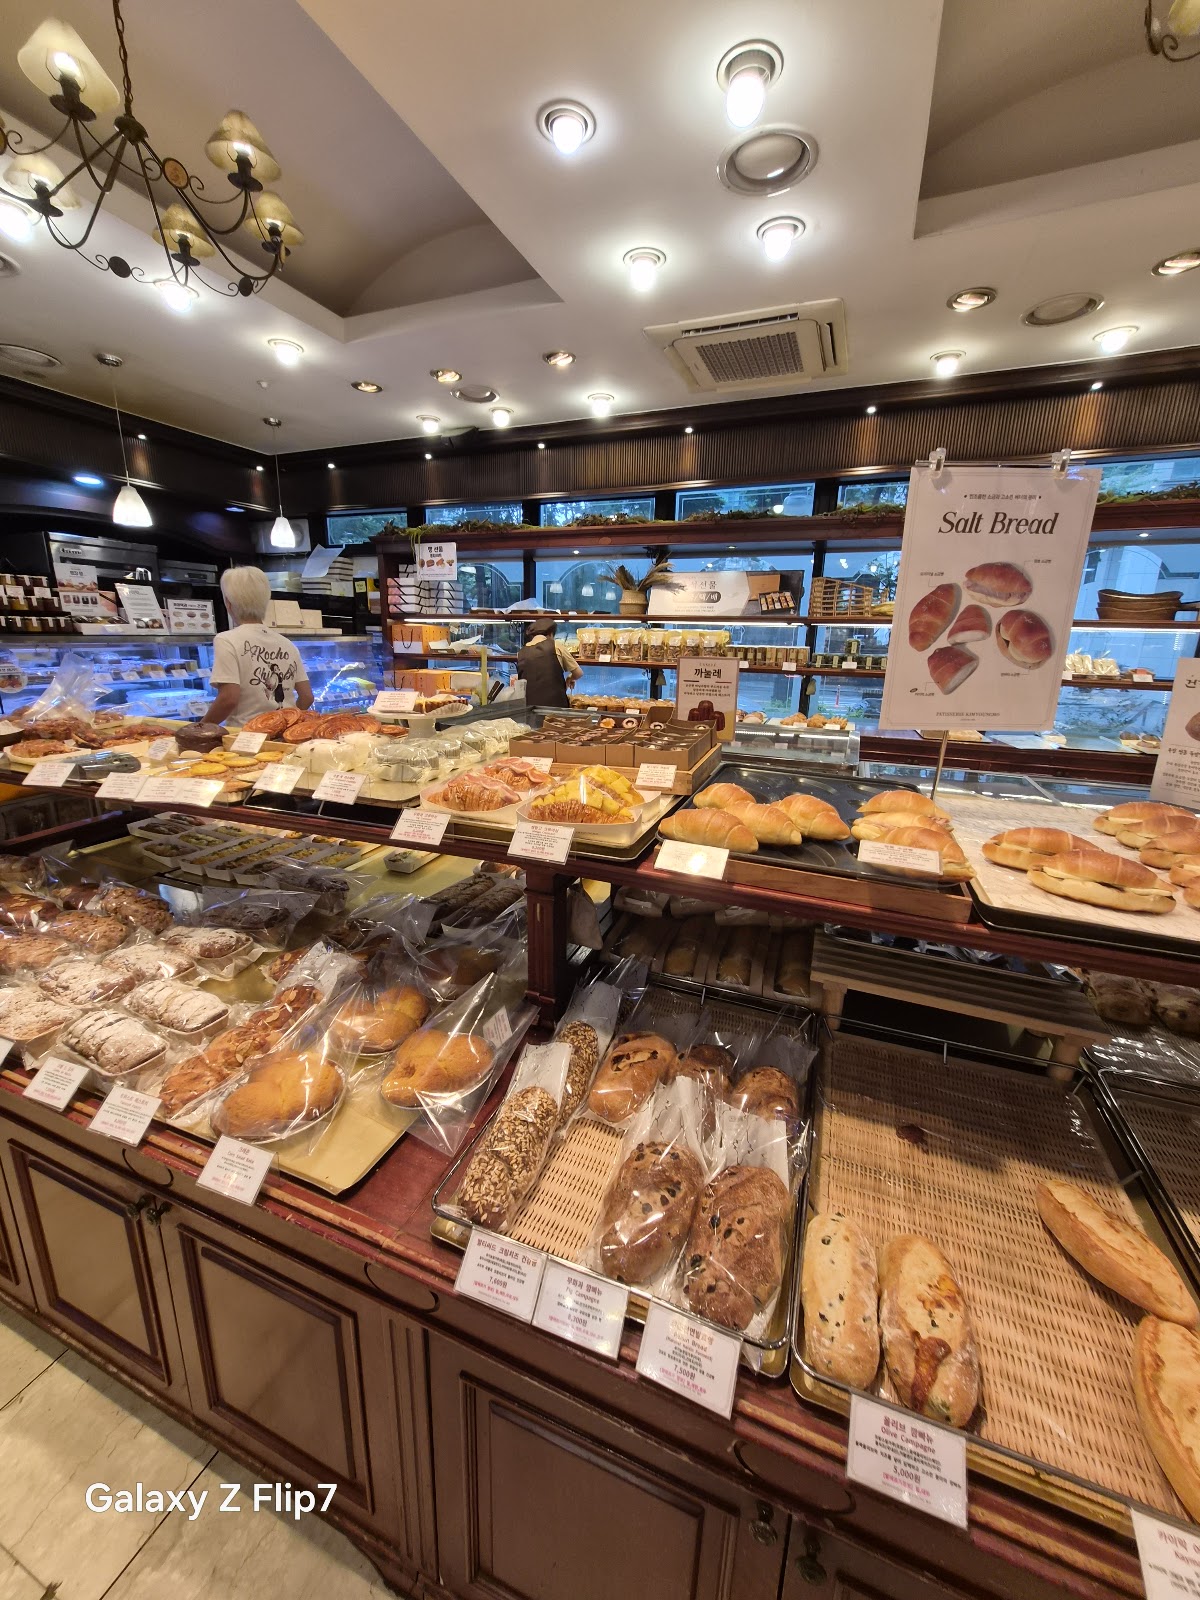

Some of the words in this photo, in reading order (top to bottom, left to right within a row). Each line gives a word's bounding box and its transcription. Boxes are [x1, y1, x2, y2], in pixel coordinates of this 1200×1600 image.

[938, 511, 984, 534] Salt
[988, 511, 1060, 535] Bread
[256, 647, 289, 664] Kocho
[694, 668, 722, 679] 까눌레
[498, 1245, 520, 1261] 크림치즈
[566, 1277, 584, 1290] 무화과
[691, 1340, 708, 1353] Bread
[674, 1364, 696, 1381] 7,500원
[883, 1415, 907, 1434] 올리브
[910, 1426, 934, 1445] 깜빠뉴
[880, 1426, 898, 1439] Olive
[900, 1434, 936, 1455] Campagne
[893, 1465, 921, 1485] 5,000원
[1157, 1528, 1188, 1552] 카이막
